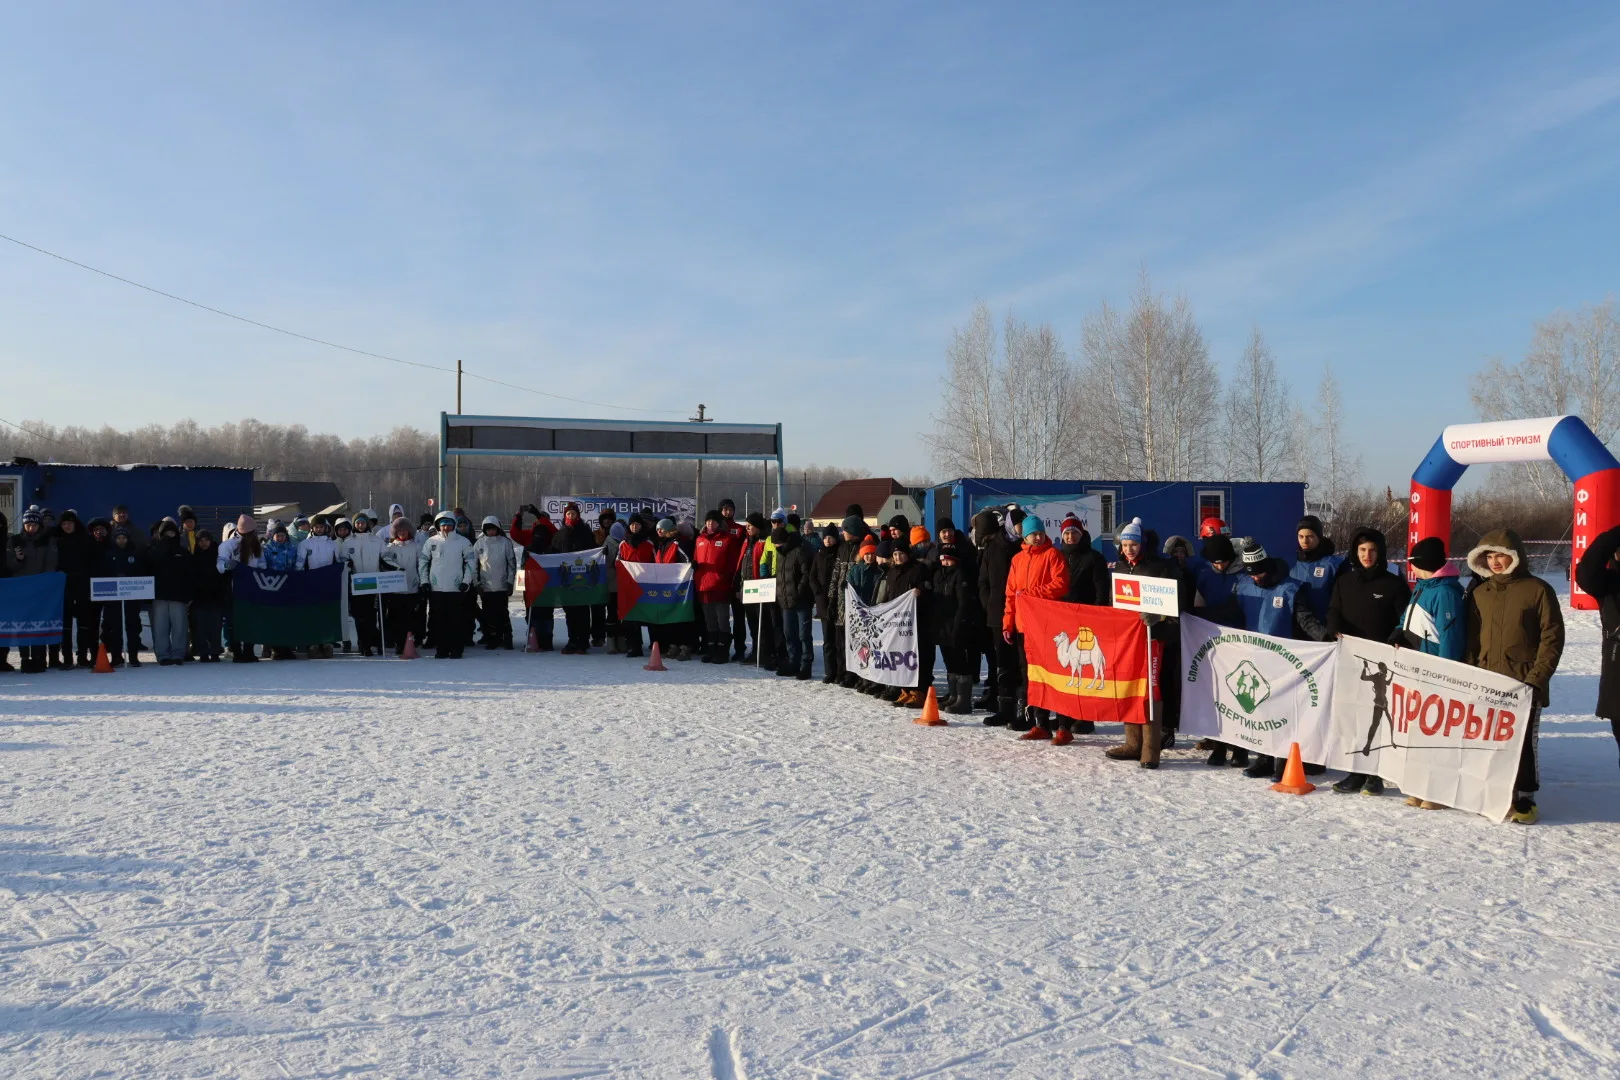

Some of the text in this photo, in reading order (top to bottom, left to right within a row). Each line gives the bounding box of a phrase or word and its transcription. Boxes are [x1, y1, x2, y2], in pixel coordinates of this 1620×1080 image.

[1451, 434, 1541, 450] СПОРТИВНЫЙ ТУРИЗМ
[1573, 489, 1589, 595] ФИНШ
[1213, 634, 1242, 646] ШКОЛА
[1300, 668, 1319, 708] РЕЗЕРВА
[1422, 669, 1479, 690] СПОРТИВНОГО
[1480, 685, 1519, 700] ТУРИЗМА
[1214, 701, 1288, 731] «ВЕРТИКАЛЬ»
[1392, 683, 1516, 741] ПРОРЫВ
[1485, 695, 1518, 708] Карталы
